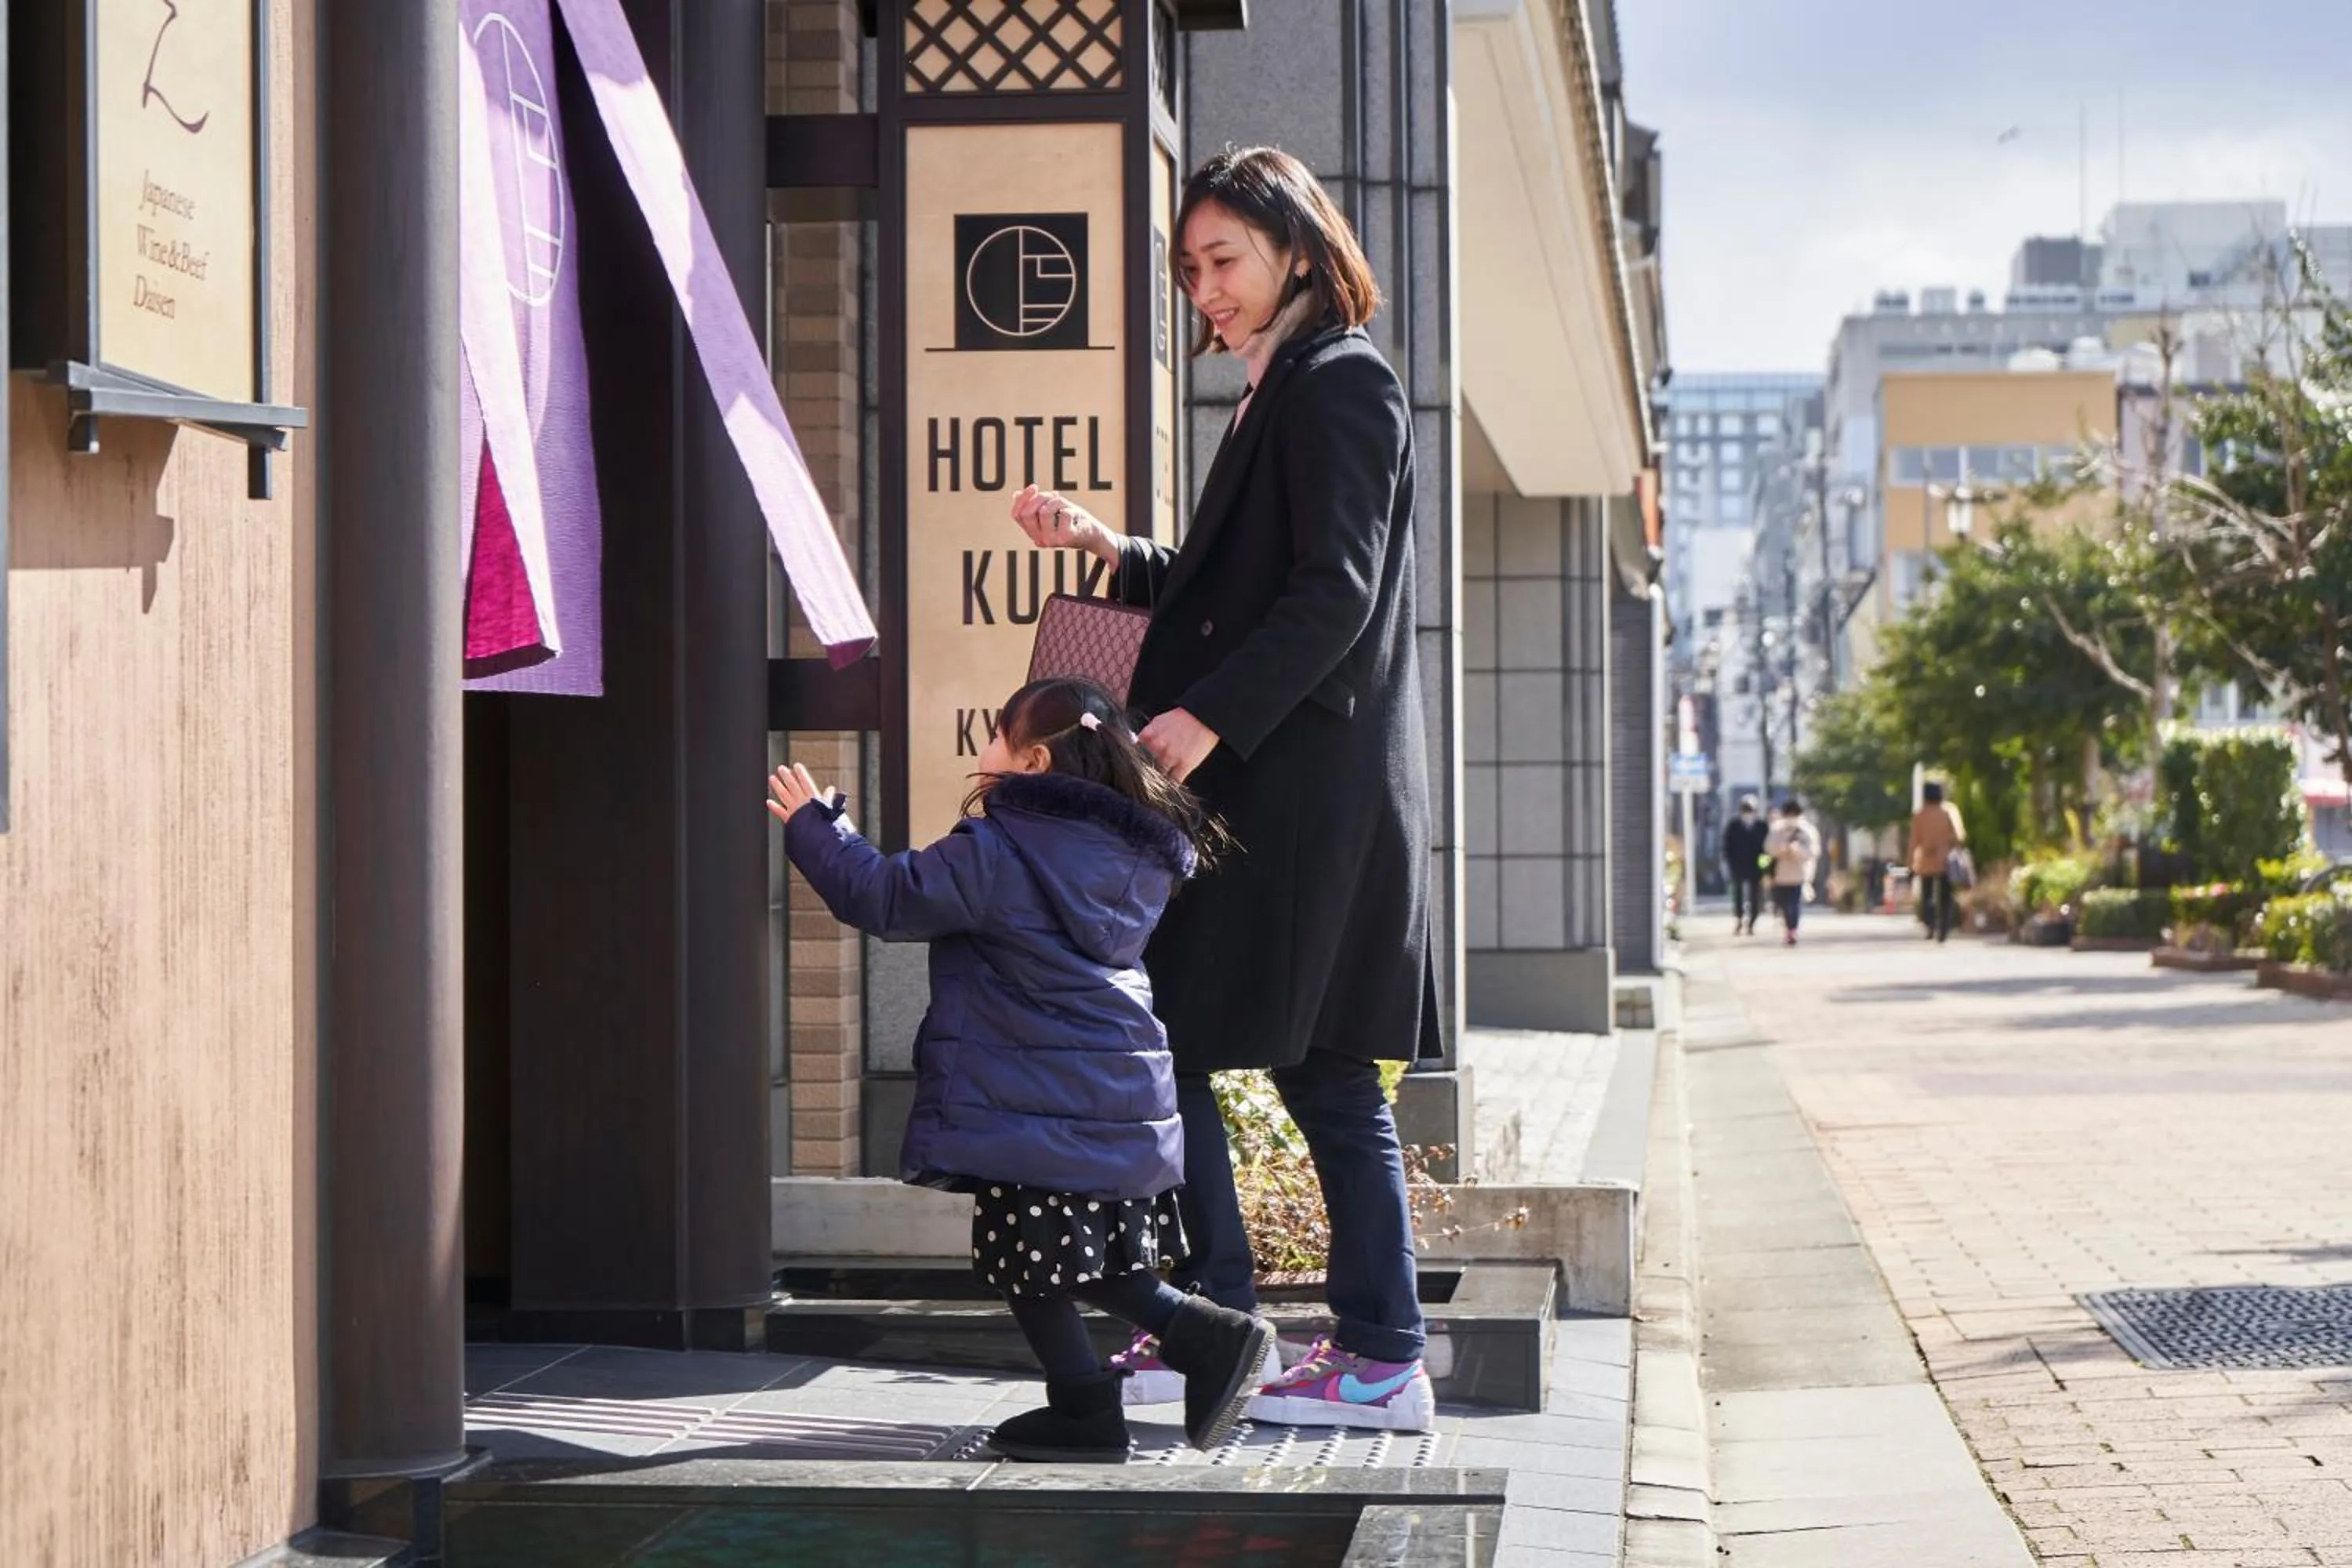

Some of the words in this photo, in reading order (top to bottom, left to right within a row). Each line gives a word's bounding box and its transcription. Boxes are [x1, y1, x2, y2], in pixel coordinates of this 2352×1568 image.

[138, 169, 195, 220] Japanese
[133, 274, 175, 320] Daisen
[927, 416, 1112, 492] HOTEL
